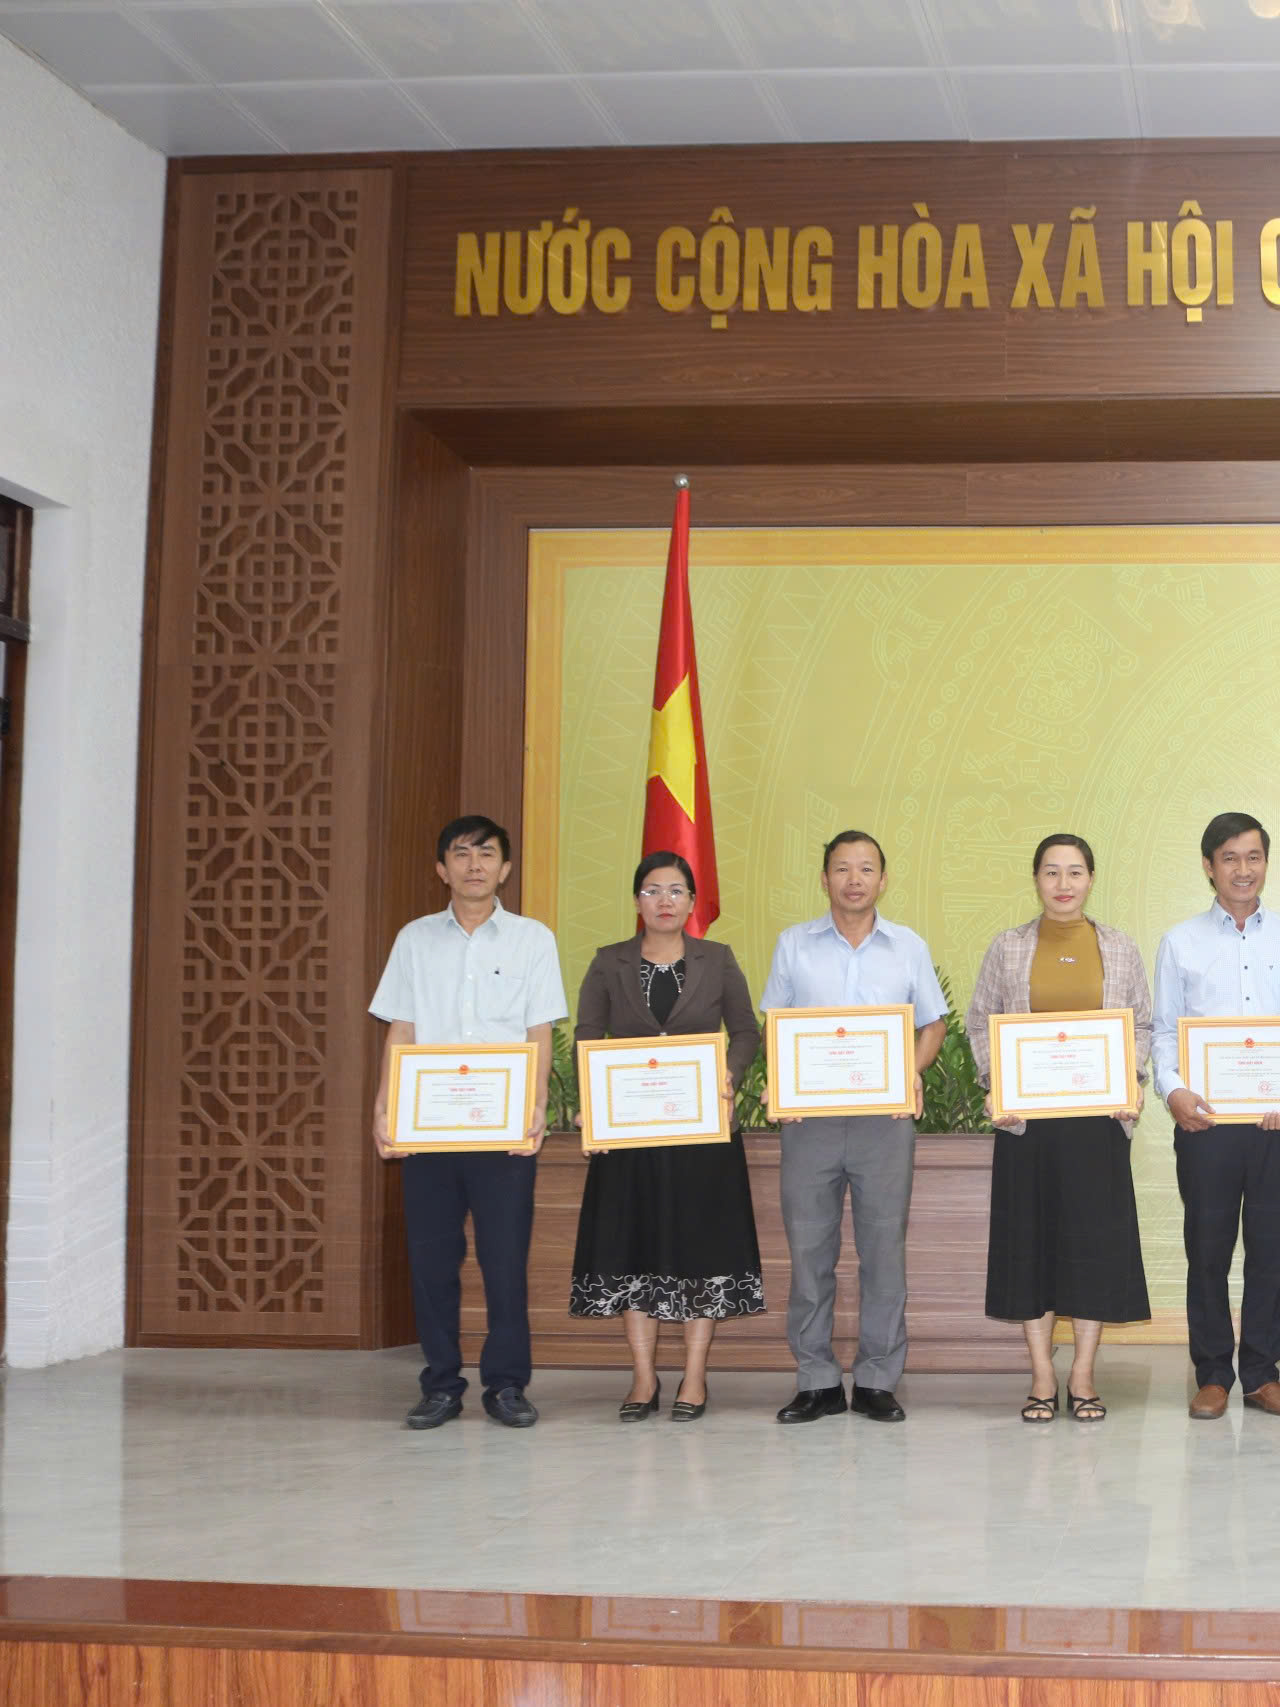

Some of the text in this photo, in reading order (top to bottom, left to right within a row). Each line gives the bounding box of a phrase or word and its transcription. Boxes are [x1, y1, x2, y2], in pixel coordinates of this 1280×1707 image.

[455, 207, 632, 316] NƯỚC
[655, 205, 832, 329] CỘNG
[856, 202, 990, 310] HÒA
[1010, 206, 1104, 308] XÃ
[1126, 200, 1235, 322] HỘI
